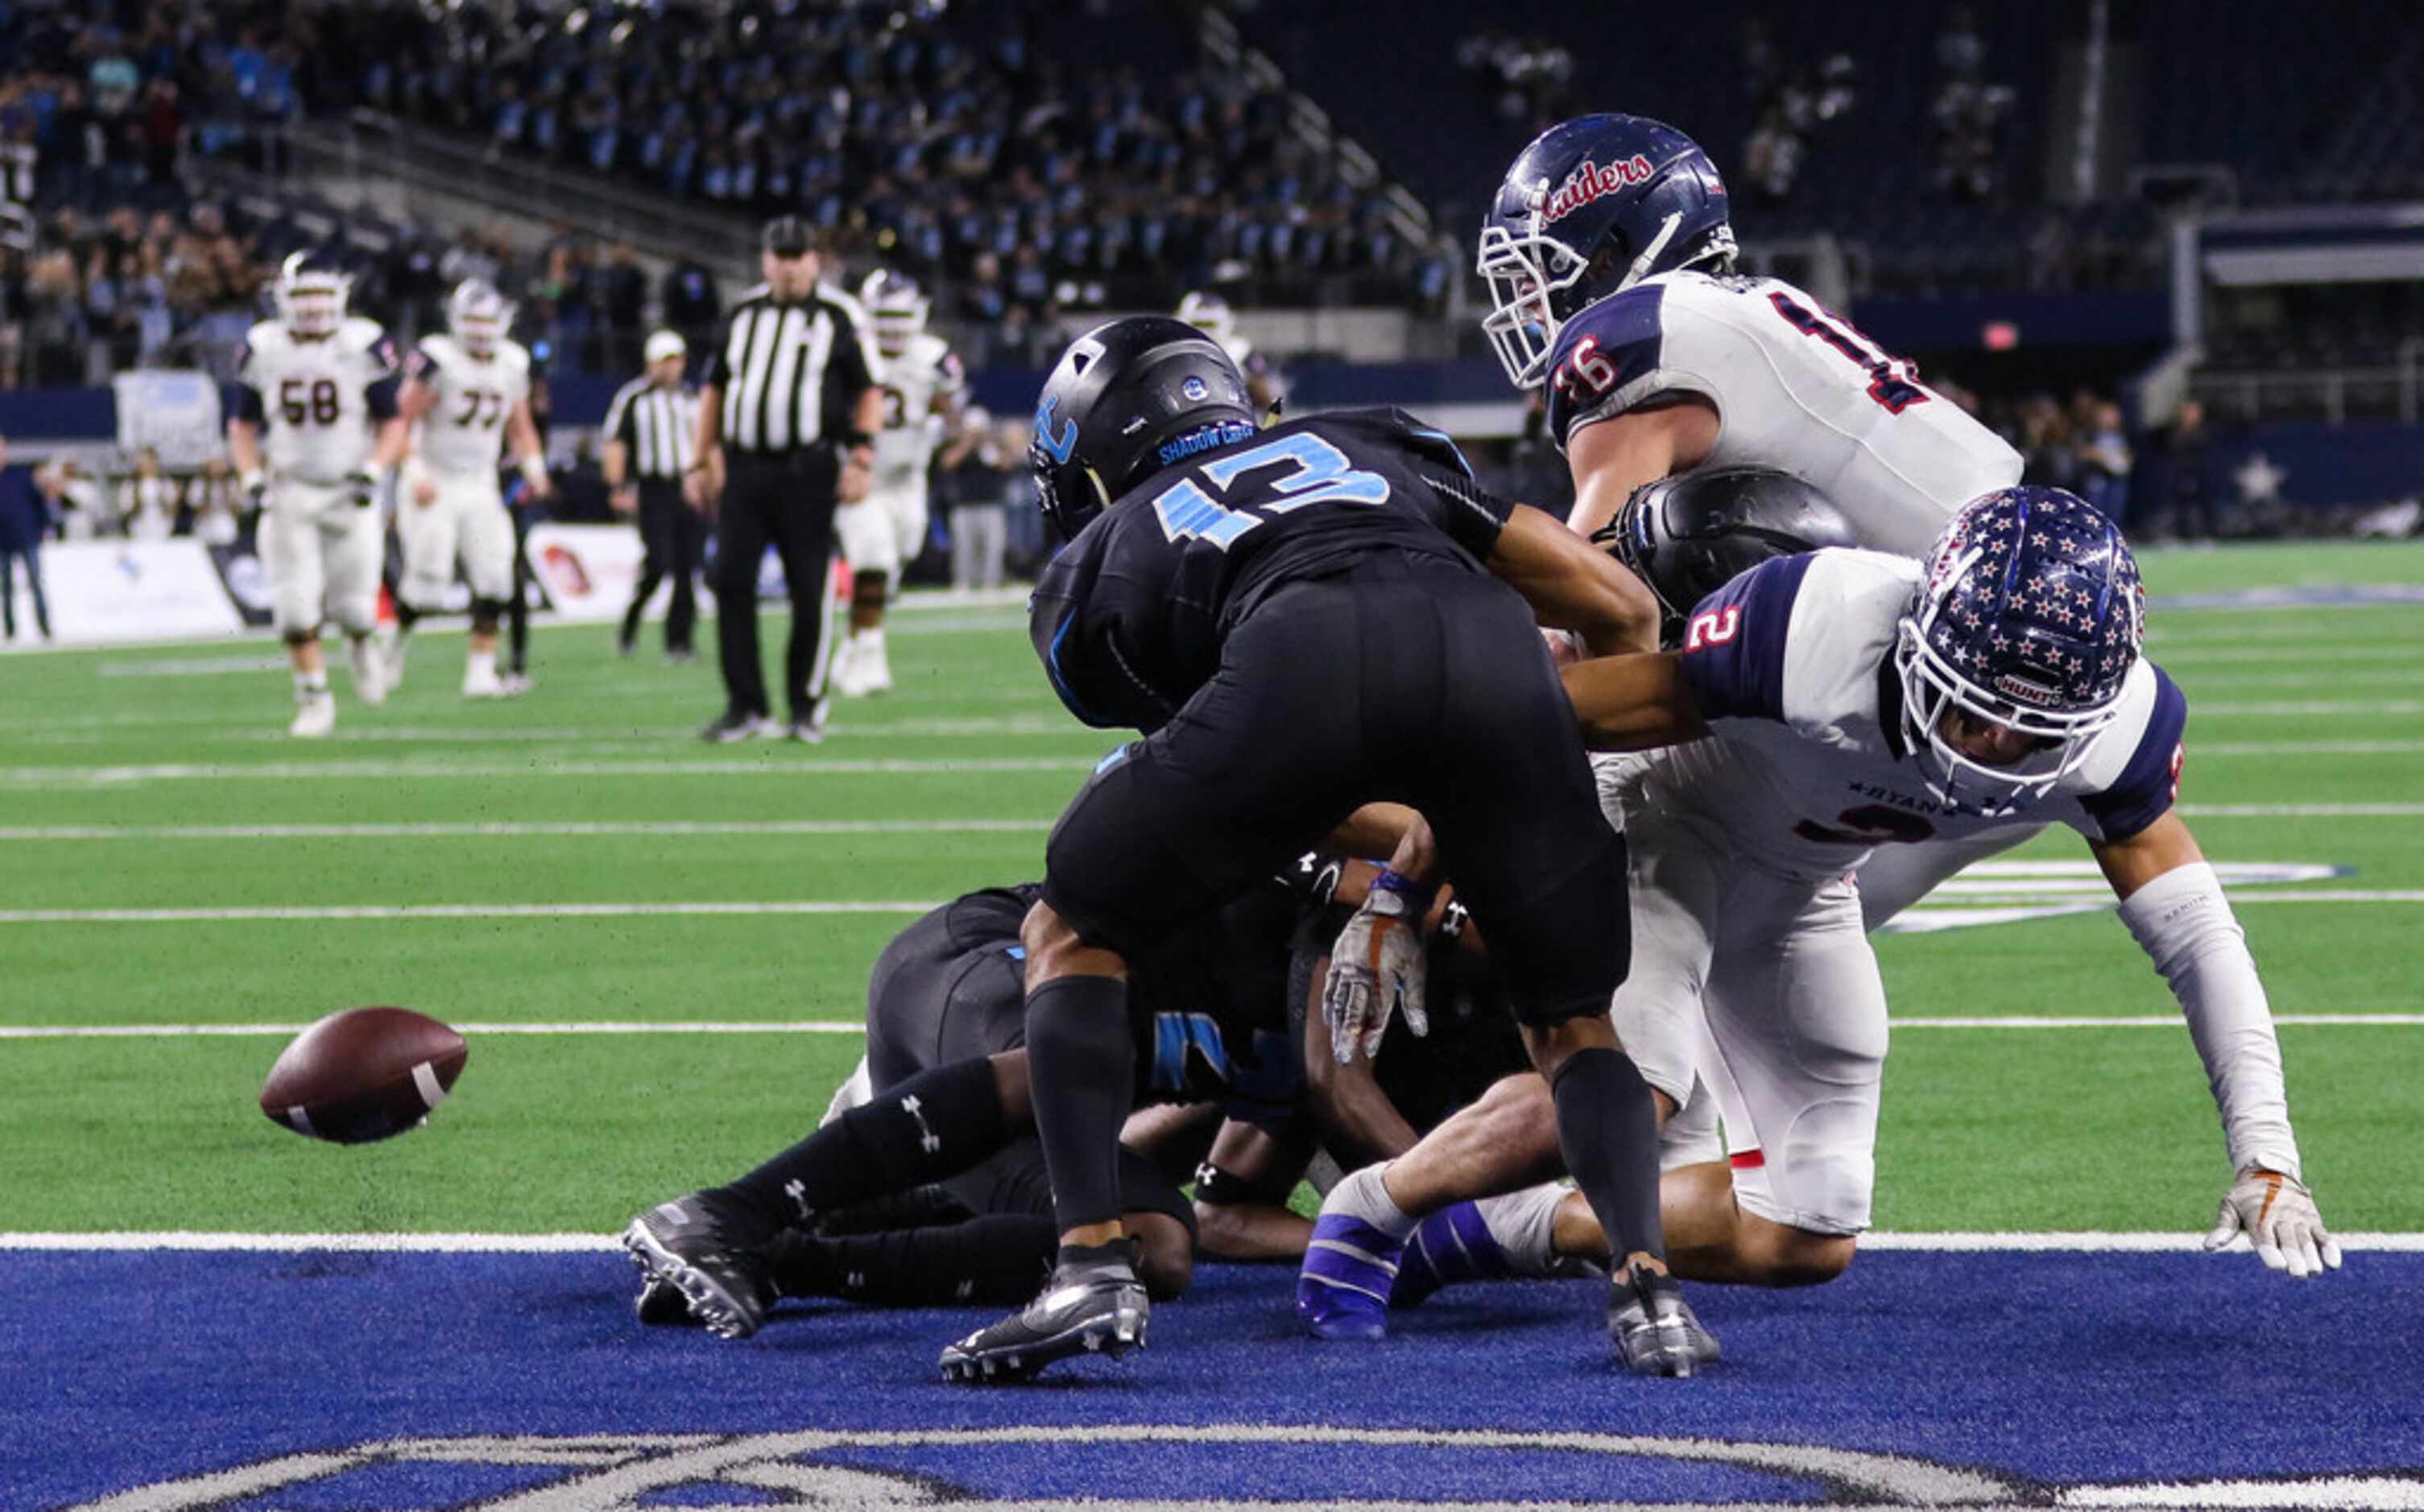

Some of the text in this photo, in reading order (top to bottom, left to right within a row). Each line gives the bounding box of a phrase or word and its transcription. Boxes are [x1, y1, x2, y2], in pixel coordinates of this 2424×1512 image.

[280, 378, 339, 426] 58
[454, 390, 503, 430] 77
[1159, 428, 1220, 465] SHADOW
[1152, 432, 1391, 552] 13
[1684, 603, 1741, 654] 2
[1868, 786, 1938, 813] RYAN
